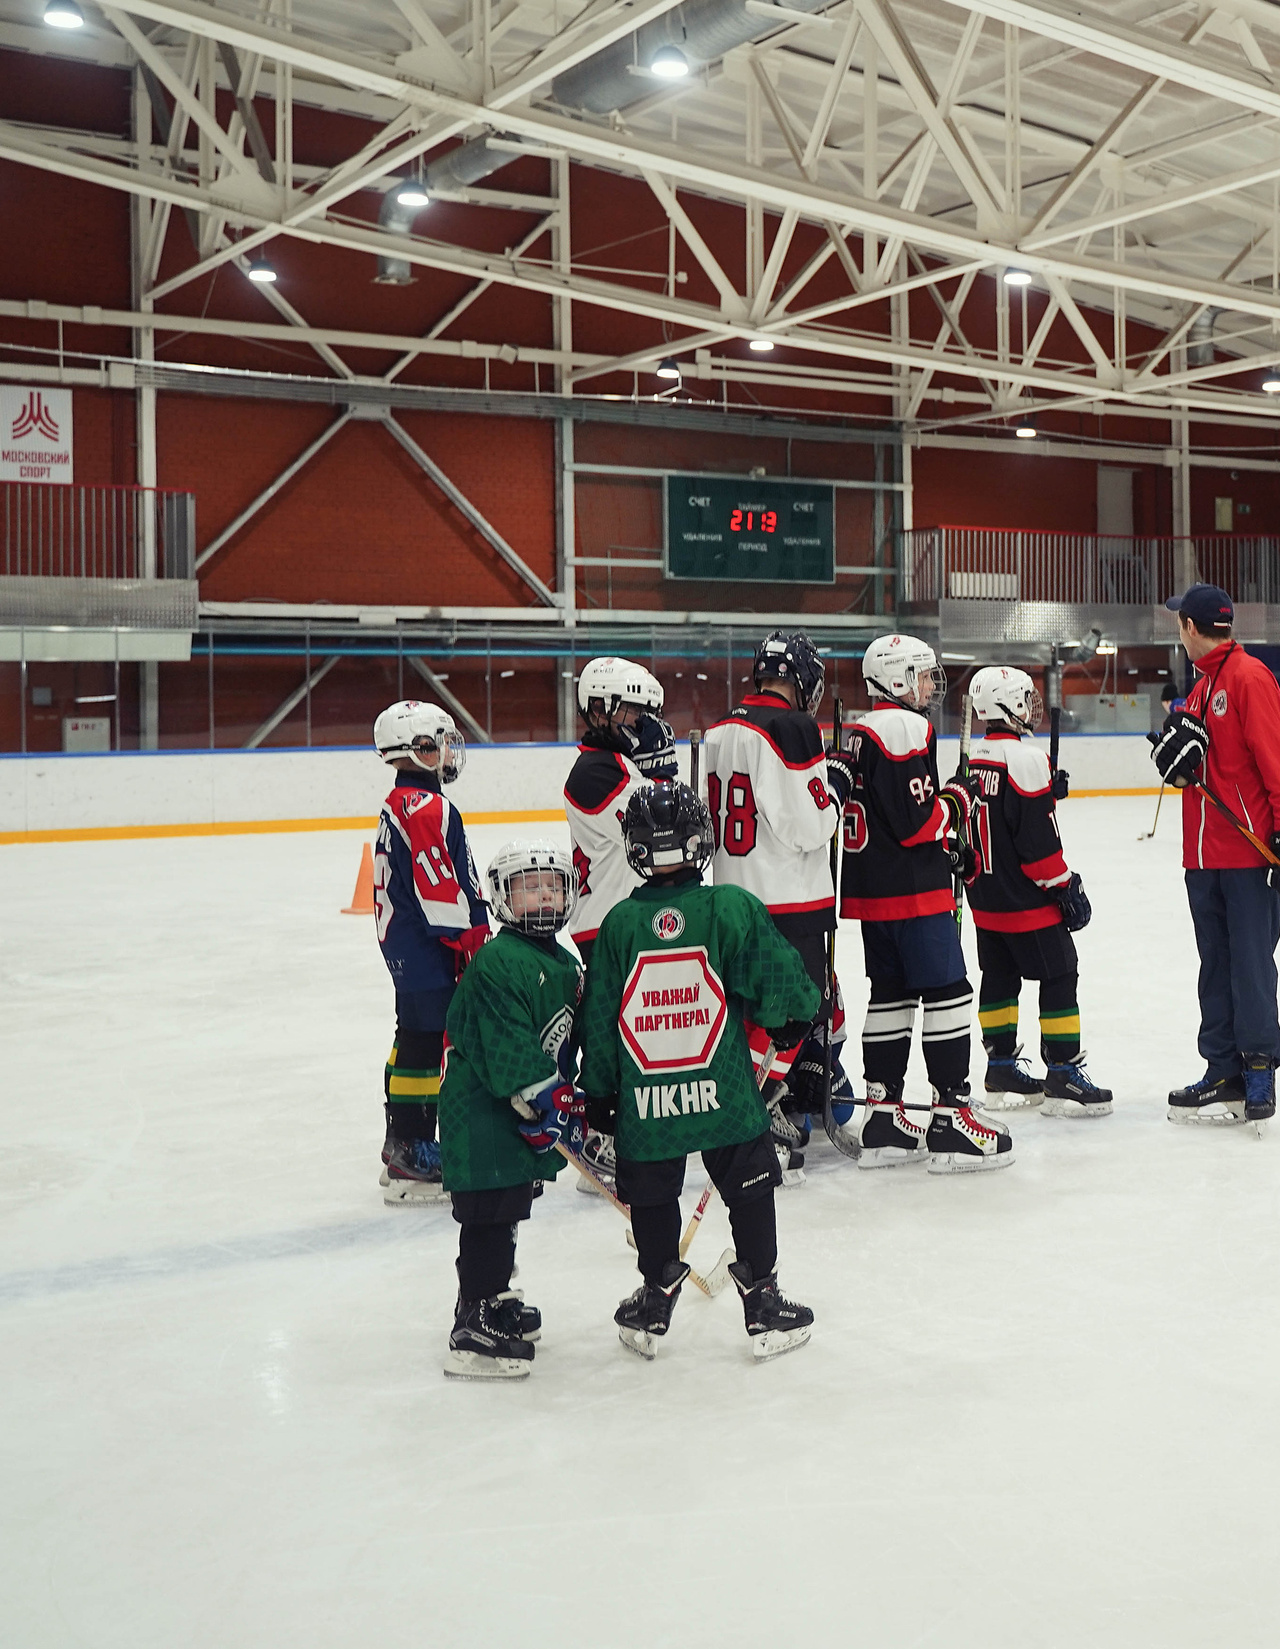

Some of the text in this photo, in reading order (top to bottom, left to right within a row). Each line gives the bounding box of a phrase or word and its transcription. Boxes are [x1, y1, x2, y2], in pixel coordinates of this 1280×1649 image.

[2, 450, 70, 465] МОСКОВСКИЙ
[20, 466, 51, 479] СПОРТ
[688, 496, 711, 507] СЧЕТ
[793, 502, 815, 512] СЧЕТ
[1181, 716, 1210, 747] Reebo
[807, 776, 831, 811] 8
[641, 982, 700, 1008] УВАЖАЙ
[634, 1008, 710, 1033] ПАРТНЕРА!
[634, 1079, 721, 1120] VIKHR
[742, 1171, 770, 1188] BAUER
